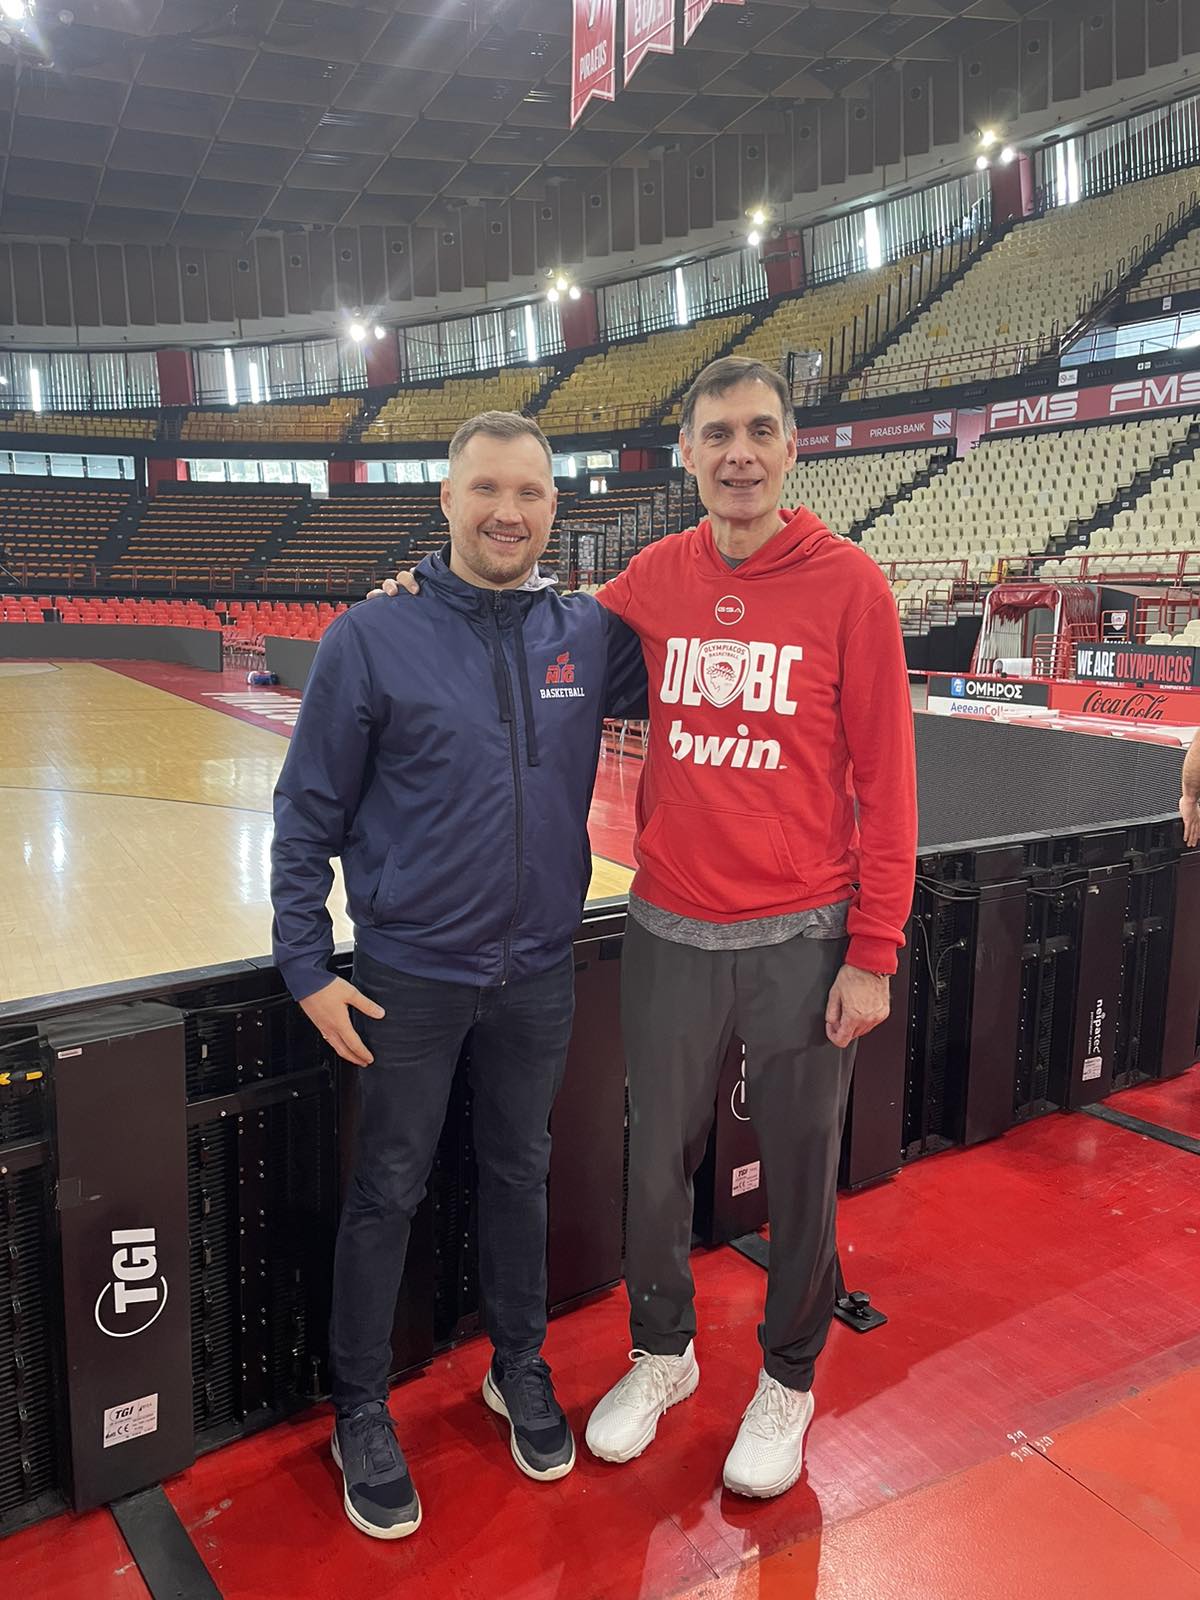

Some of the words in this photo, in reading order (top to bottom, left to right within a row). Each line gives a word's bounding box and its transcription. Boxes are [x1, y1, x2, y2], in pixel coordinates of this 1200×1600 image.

[579, 39, 608, 83] PIRAEUS
[1110, 371, 1200, 412] FMS
[990, 391, 1079, 429] FMS
[869, 424, 902, 438] PIRAEUS
[903, 422, 926, 434] BANK
[810, 435, 830, 446] BANK
[703, 644, 746, 656] OLYMPIACOS
[1077, 649, 1094, 677] WE
[1093, 650, 1116, 678] ARE
[1116, 652, 1192, 684] OLYMPIACOS
[540, 687, 585, 699] BASKETBALL
[965, 680, 1024, 699] ΟΜΗΡΟΣ
[111, 1227, 158, 1314] TGI
[115, 1405, 134, 1420] TGI
